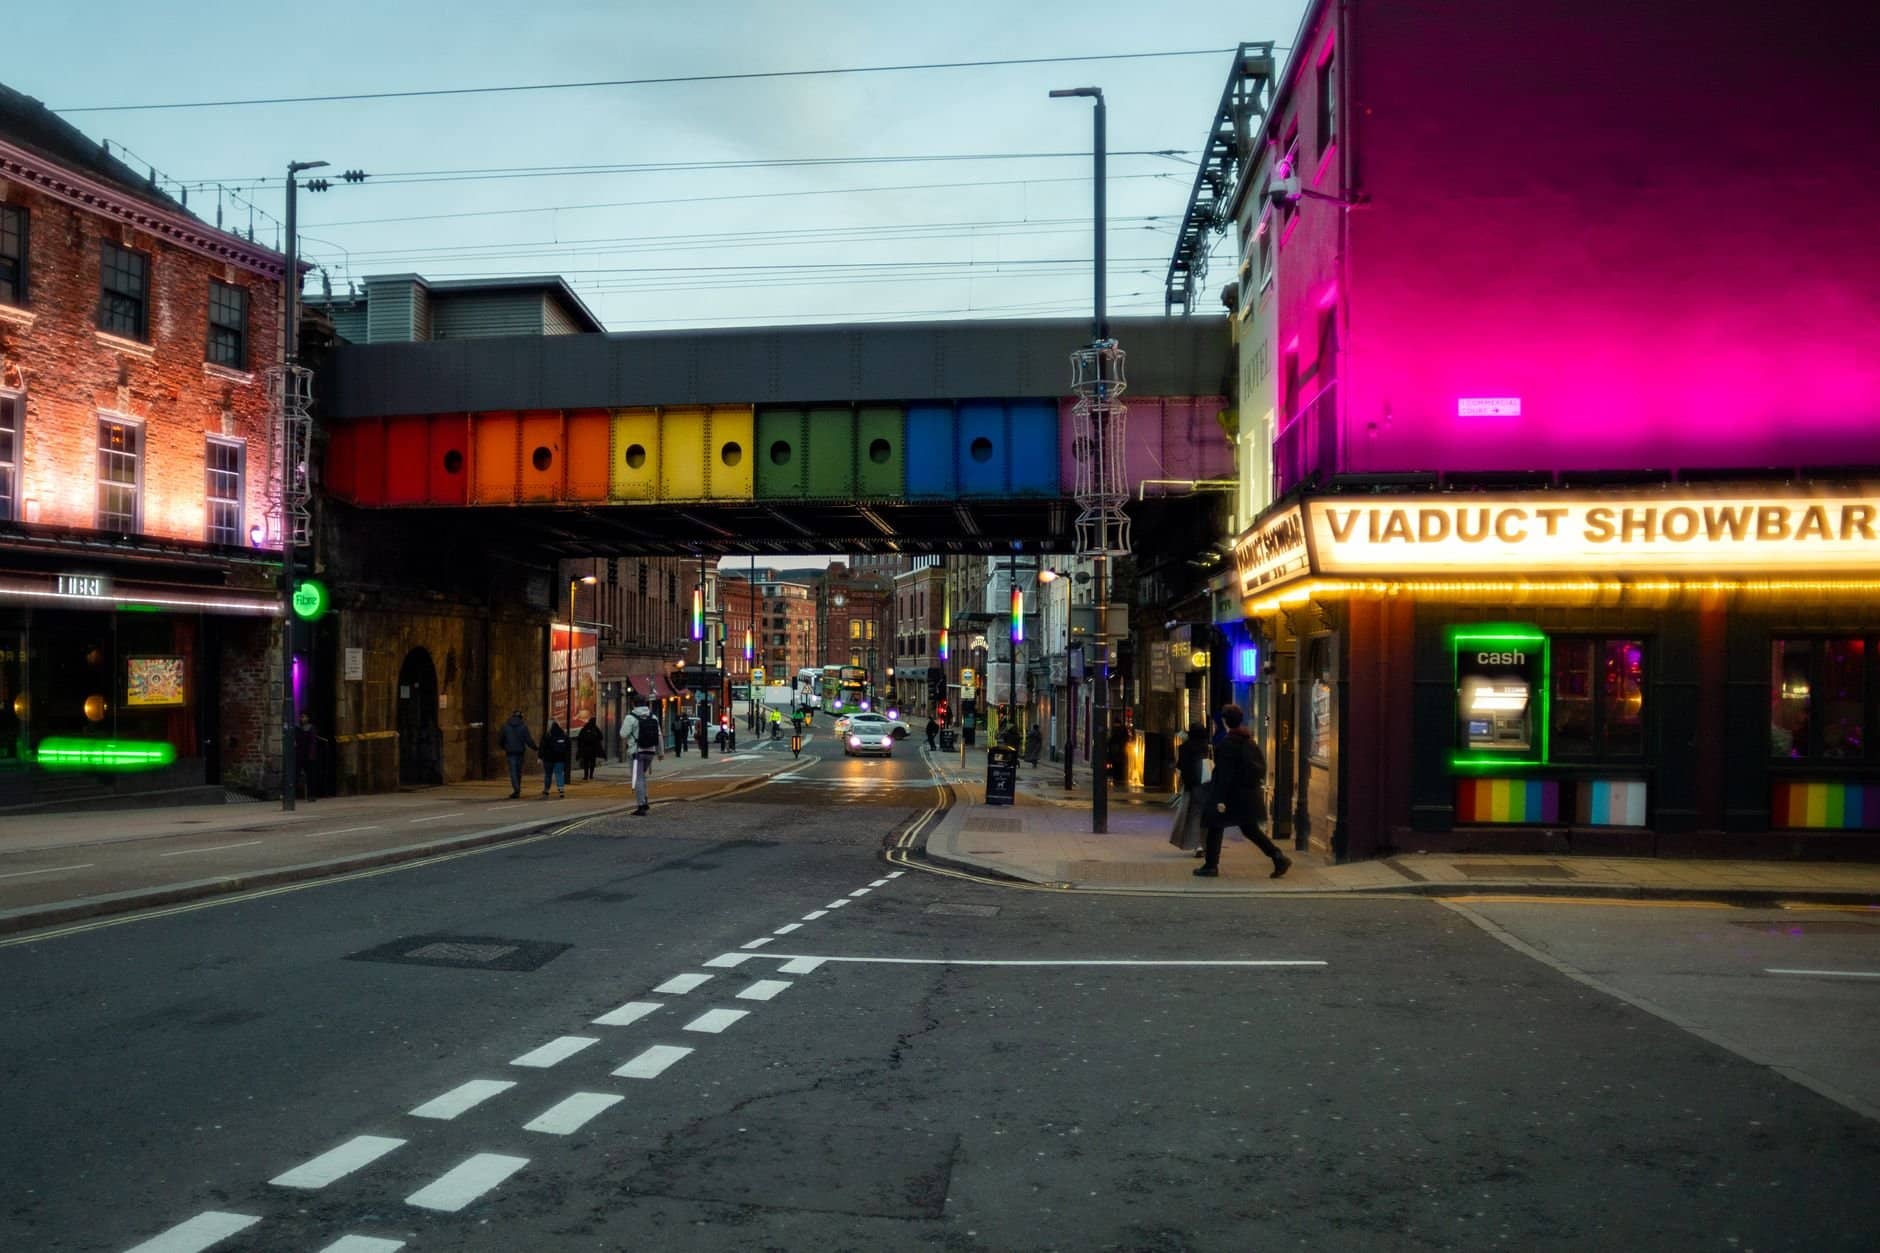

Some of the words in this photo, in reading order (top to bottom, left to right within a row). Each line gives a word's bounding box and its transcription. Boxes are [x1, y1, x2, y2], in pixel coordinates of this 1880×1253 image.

[1235, 536, 1264, 571] VIADUCT
[1263, 512, 1303, 561] SHOWBAR
[1325, 508, 1569, 543] VIADUCT
[1583, 504, 1877, 543] SHOWBAR
[1477, 648, 1525, 665] cash
